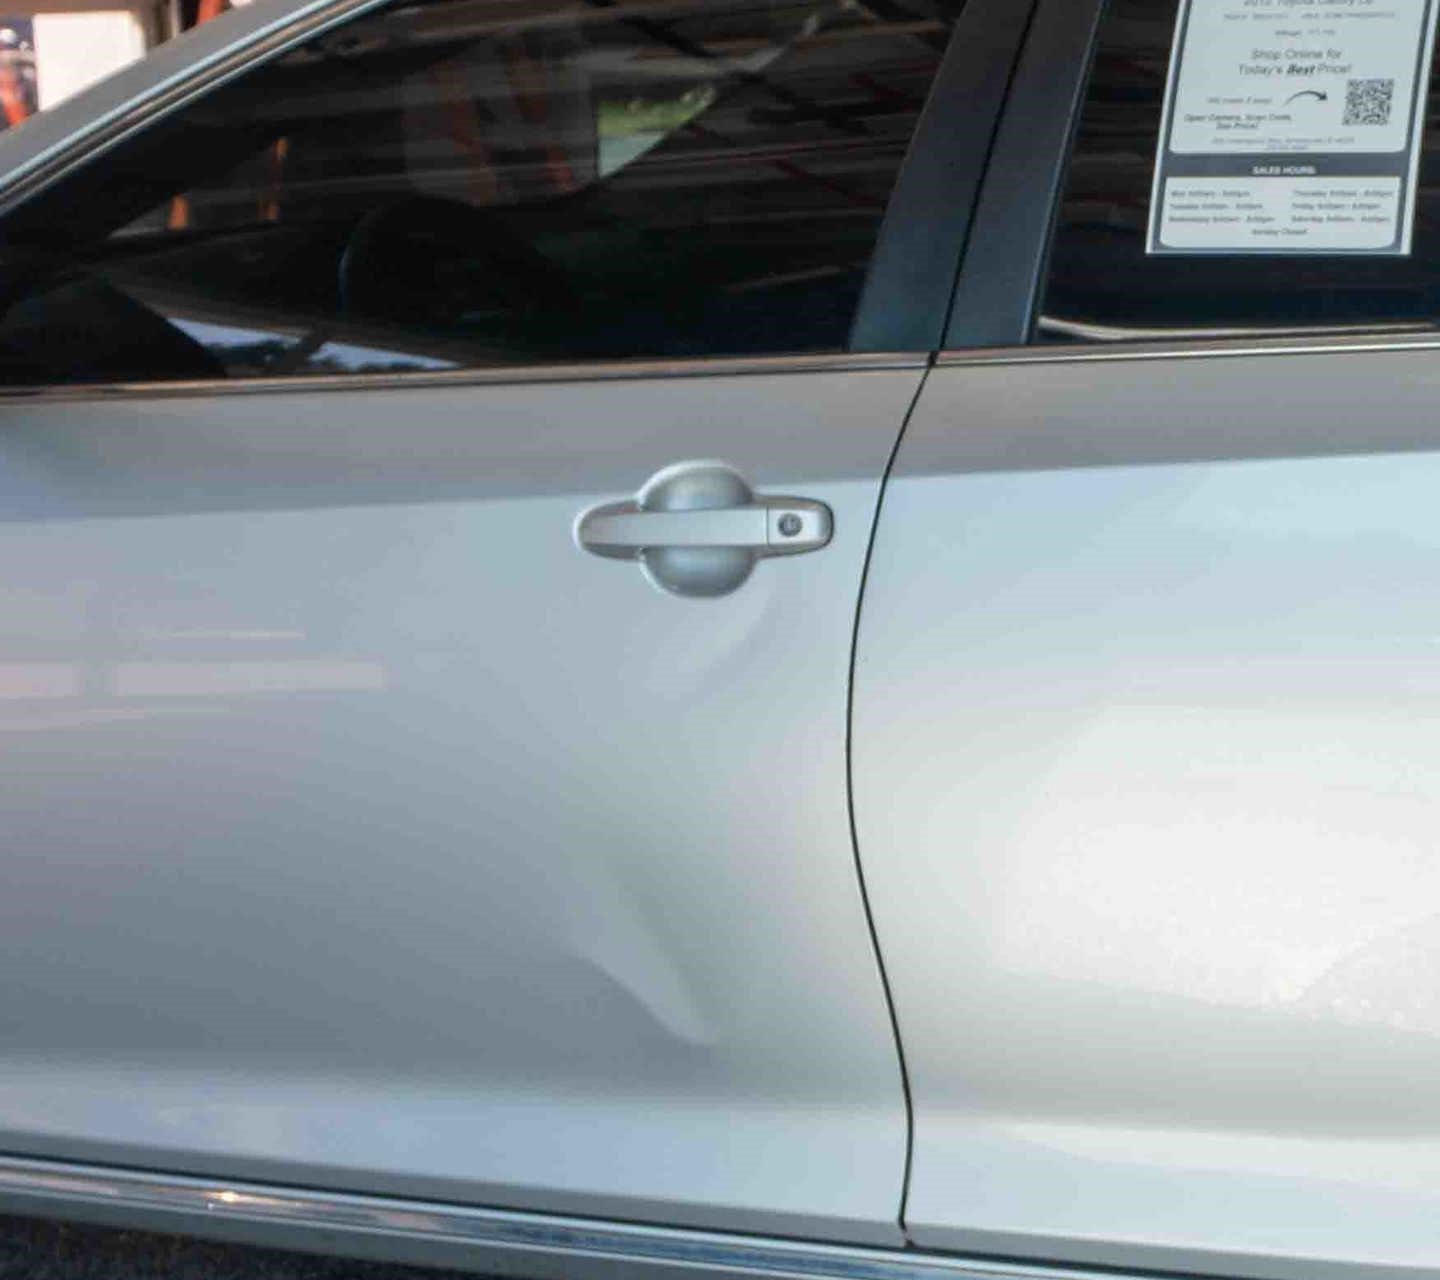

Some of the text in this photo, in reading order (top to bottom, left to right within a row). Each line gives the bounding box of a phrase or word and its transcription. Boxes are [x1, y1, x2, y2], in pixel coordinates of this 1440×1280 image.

[1252, 48, 1281, 60] Shop
[1284, 47, 1323, 60] Online
[1240, 63, 1282, 77] Today's
[1286, 62, 1316, 76] Best
